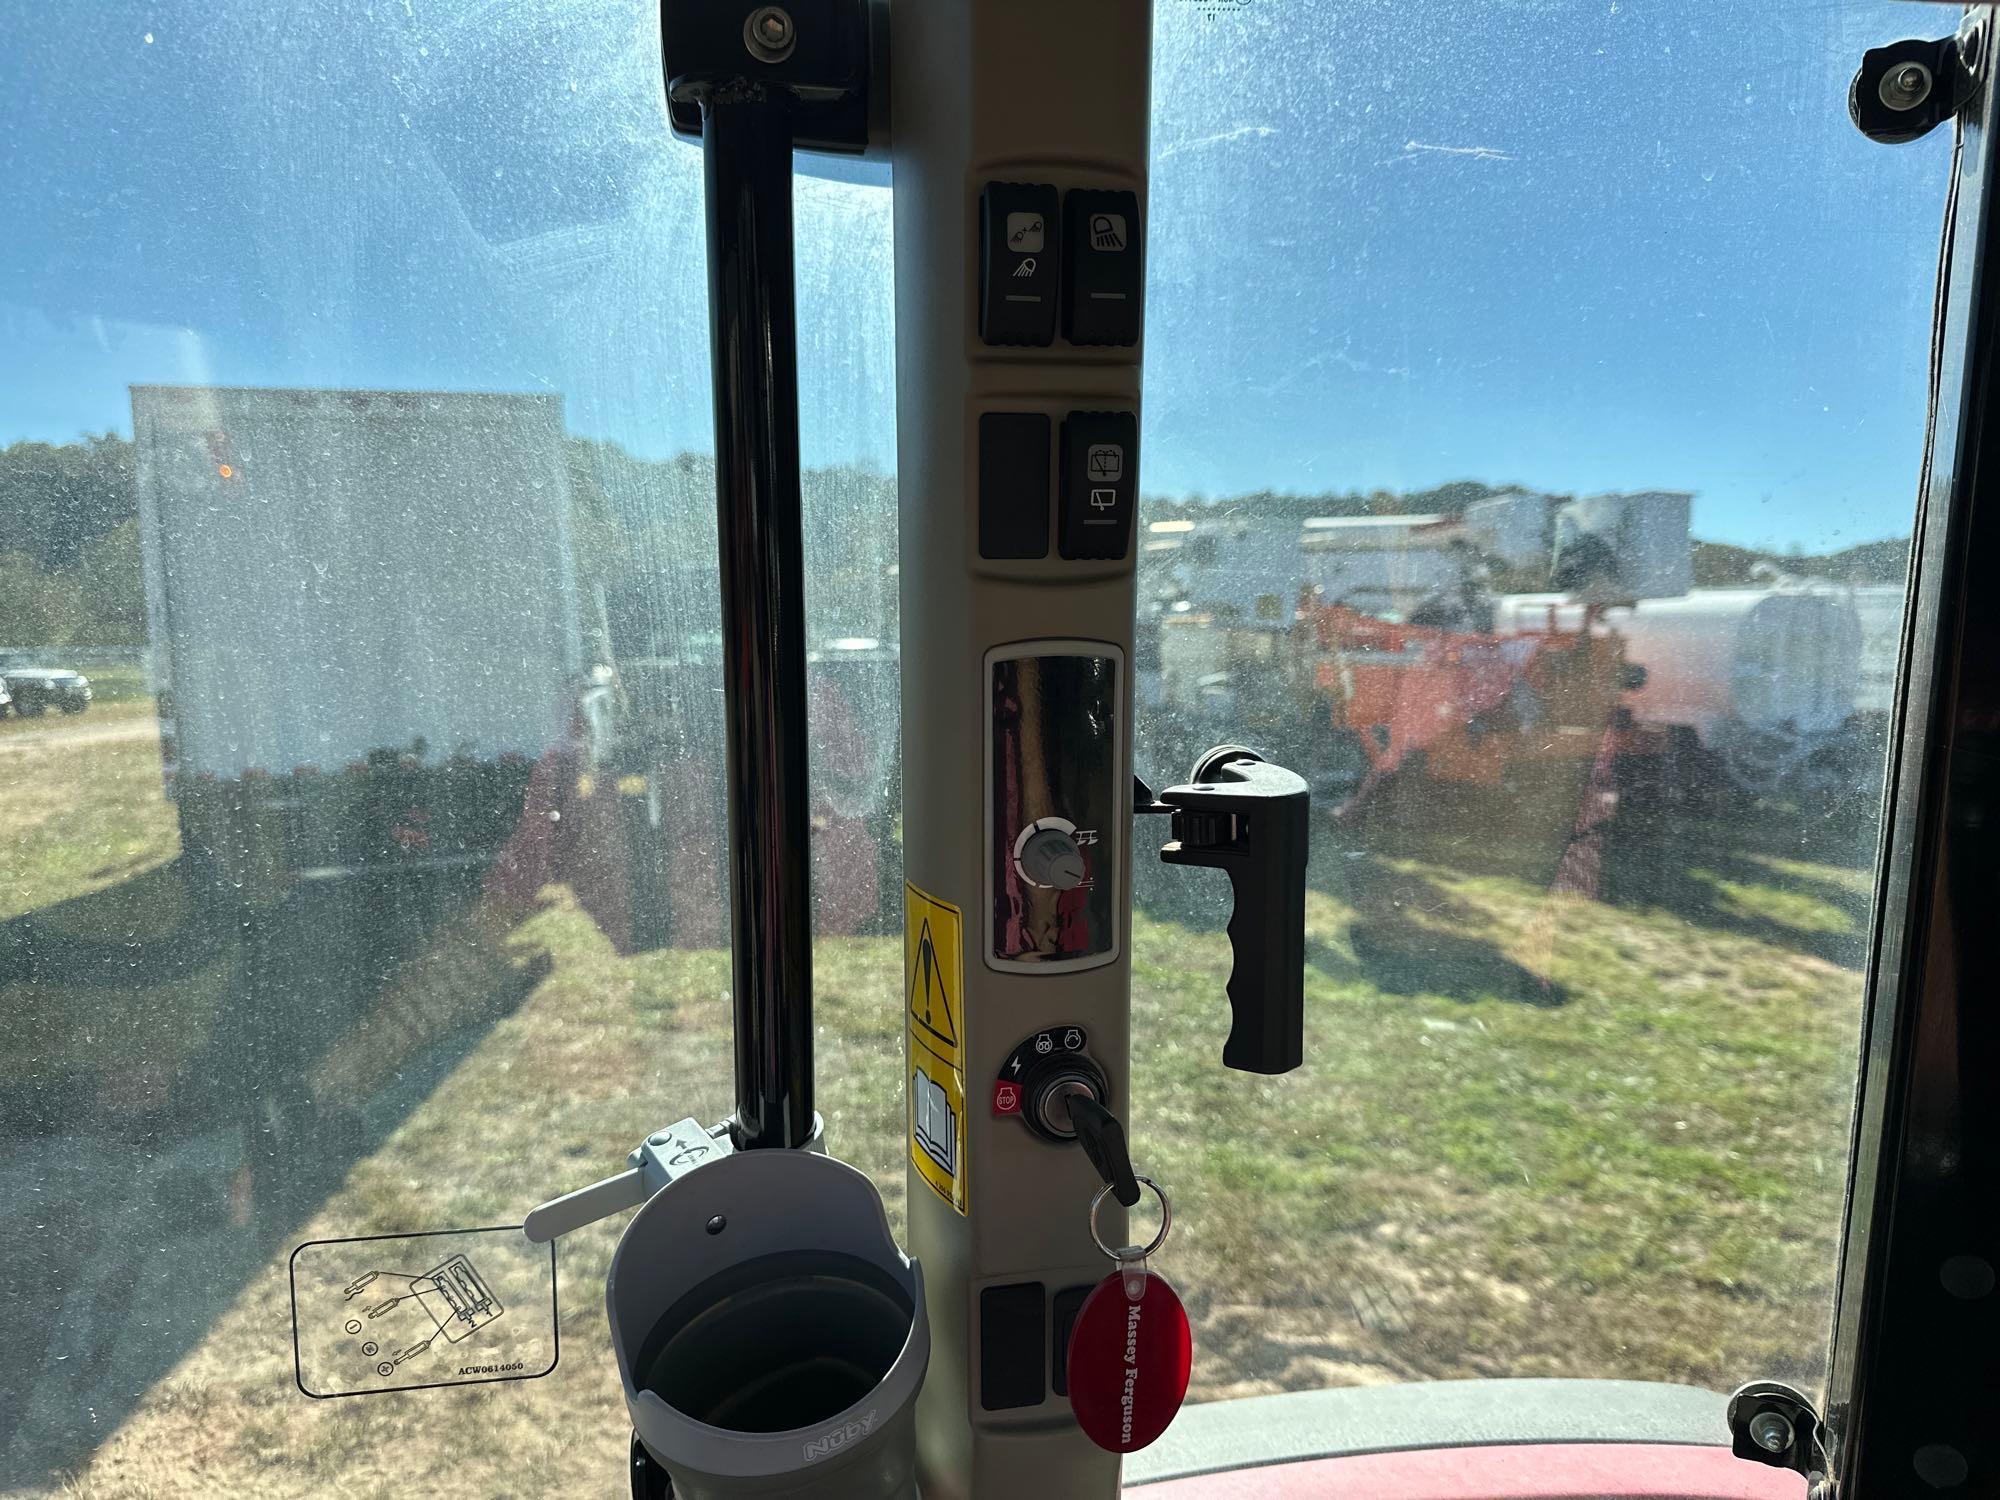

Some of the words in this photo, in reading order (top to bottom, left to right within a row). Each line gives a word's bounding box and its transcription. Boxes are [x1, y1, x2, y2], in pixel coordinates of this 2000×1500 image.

[999, 1096, 1014, 1105] STOP
[1124, 1305, 1141, 1364] Massey
[458, 1363, 523, 1376] ACW0614050
[1121, 1367, 1138, 1444] Ferguson
